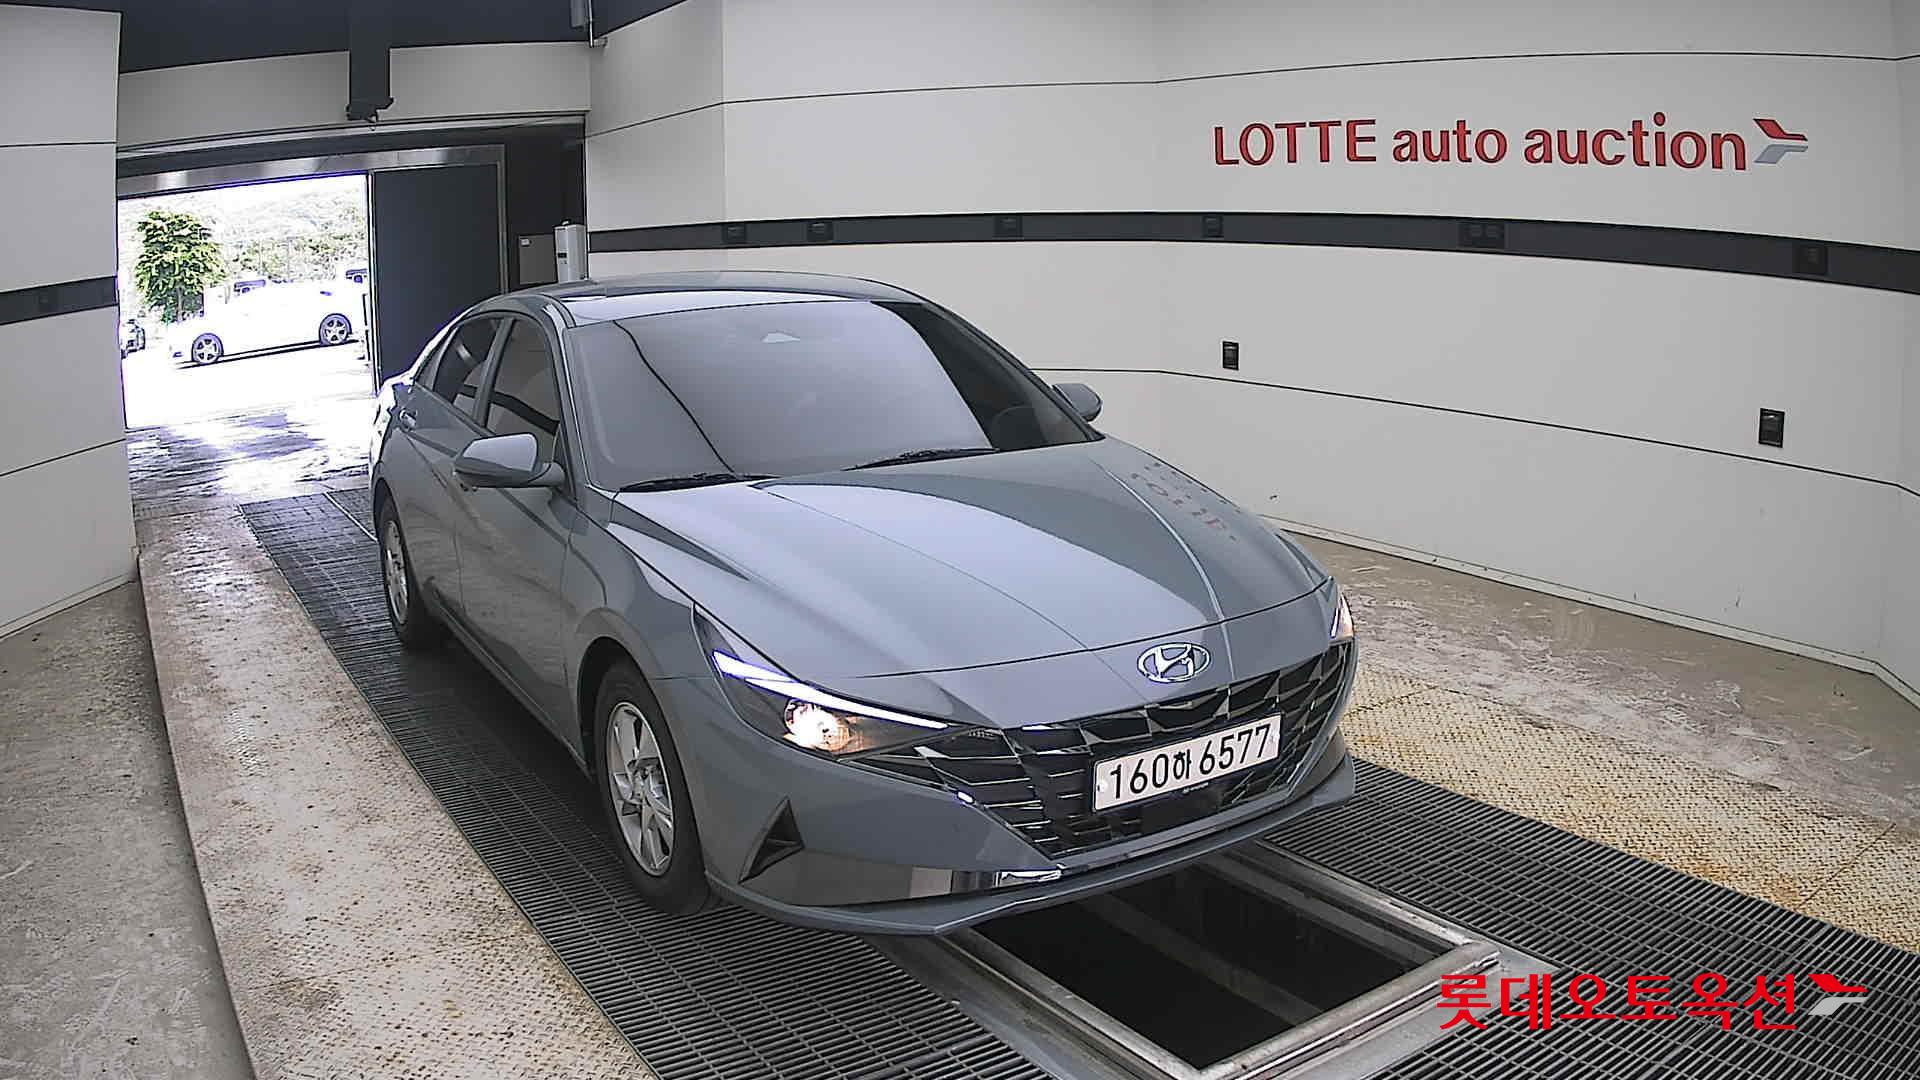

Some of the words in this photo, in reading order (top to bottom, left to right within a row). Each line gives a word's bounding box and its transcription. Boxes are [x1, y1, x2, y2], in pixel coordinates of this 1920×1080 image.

[1213, 118, 1377, 166] LOTTE
[1392, 119, 1508, 165] auto
[1523, 111, 1747, 171] auction
[1110, 749, 1192, 799] 160하
[1199, 723, 1271, 775] 6577
